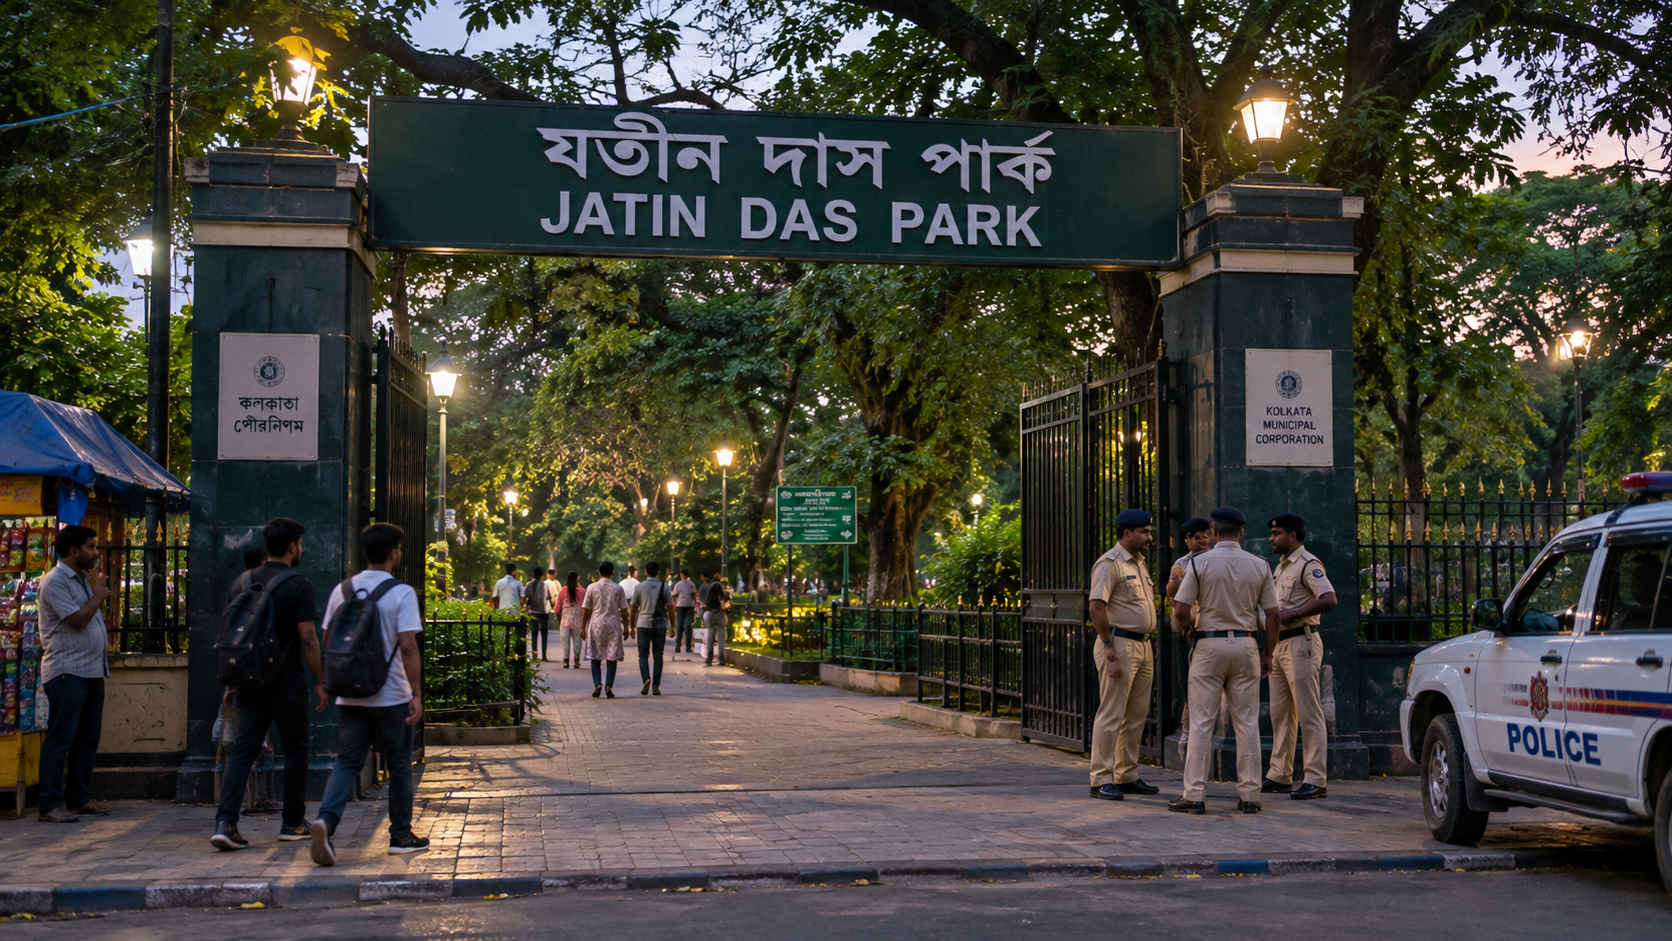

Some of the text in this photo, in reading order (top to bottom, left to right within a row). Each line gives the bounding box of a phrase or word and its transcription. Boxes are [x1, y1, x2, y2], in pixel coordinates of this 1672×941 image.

[536, 110, 1056, 194] যতীন দাস পার্ক
[541, 191, 1042, 247] JATIN DAS PARK
[238, 396, 300, 411] কলকাতা
[1266, 406, 1312, 416] KOLKATA
[1263, 420, 1316, 430] MUNICIPAL
[1255, 434, 1324, 445] CORPORATION
[1507, 723, 1602, 766] POLICE
